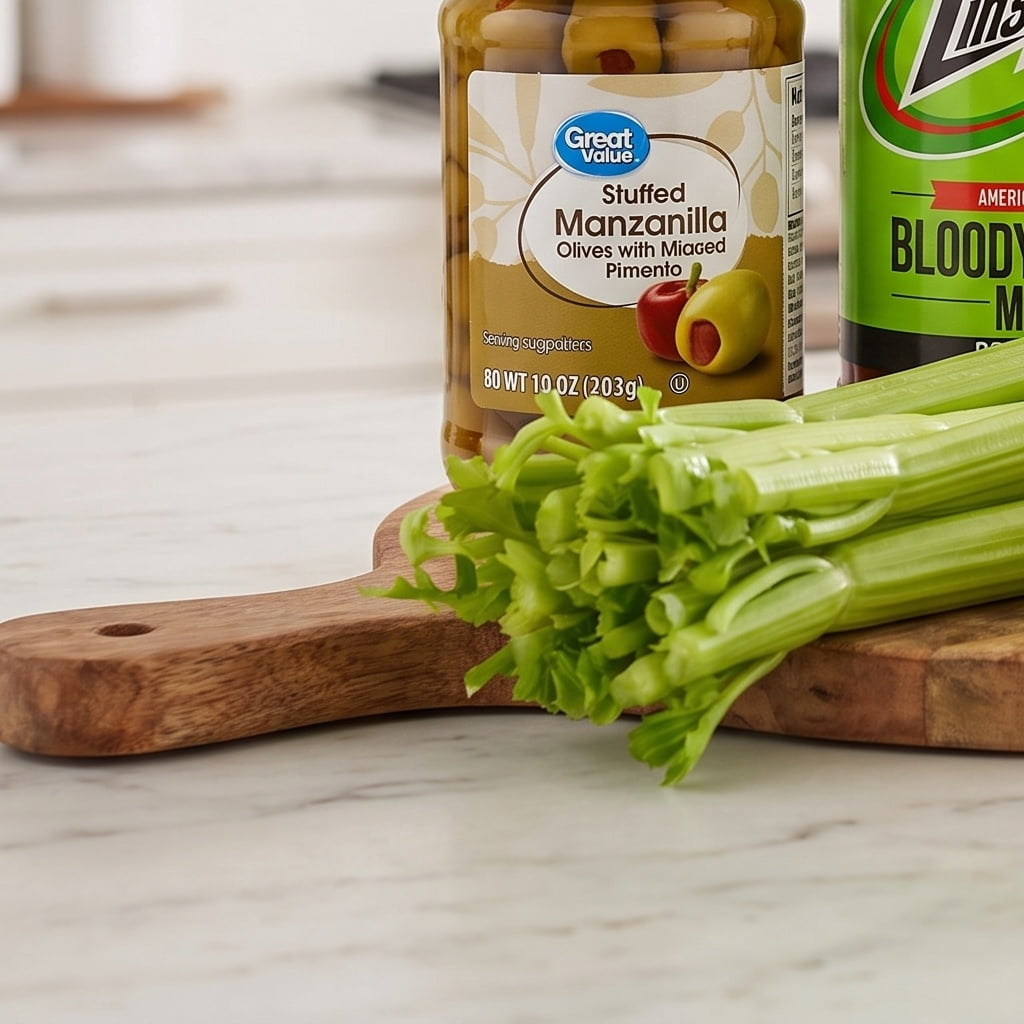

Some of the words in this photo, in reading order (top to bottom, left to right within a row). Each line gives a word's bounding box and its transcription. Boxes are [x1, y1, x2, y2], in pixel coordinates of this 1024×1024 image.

[564, 126, 633, 149] Great
[581, 147, 633, 163] Value
[602, 182, 685, 204] Stuffed
[555, 206, 727, 237] Manzanilla
[556, 241, 613, 259] Olives
[618, 241, 655, 258] with
[606, 261, 683, 278] Pimento
[484, 367, 500, 390] 80
[504, 370, 527, 393] WT
[532, 374, 551, 394] 10
[556, 375, 579, 396] OZ
